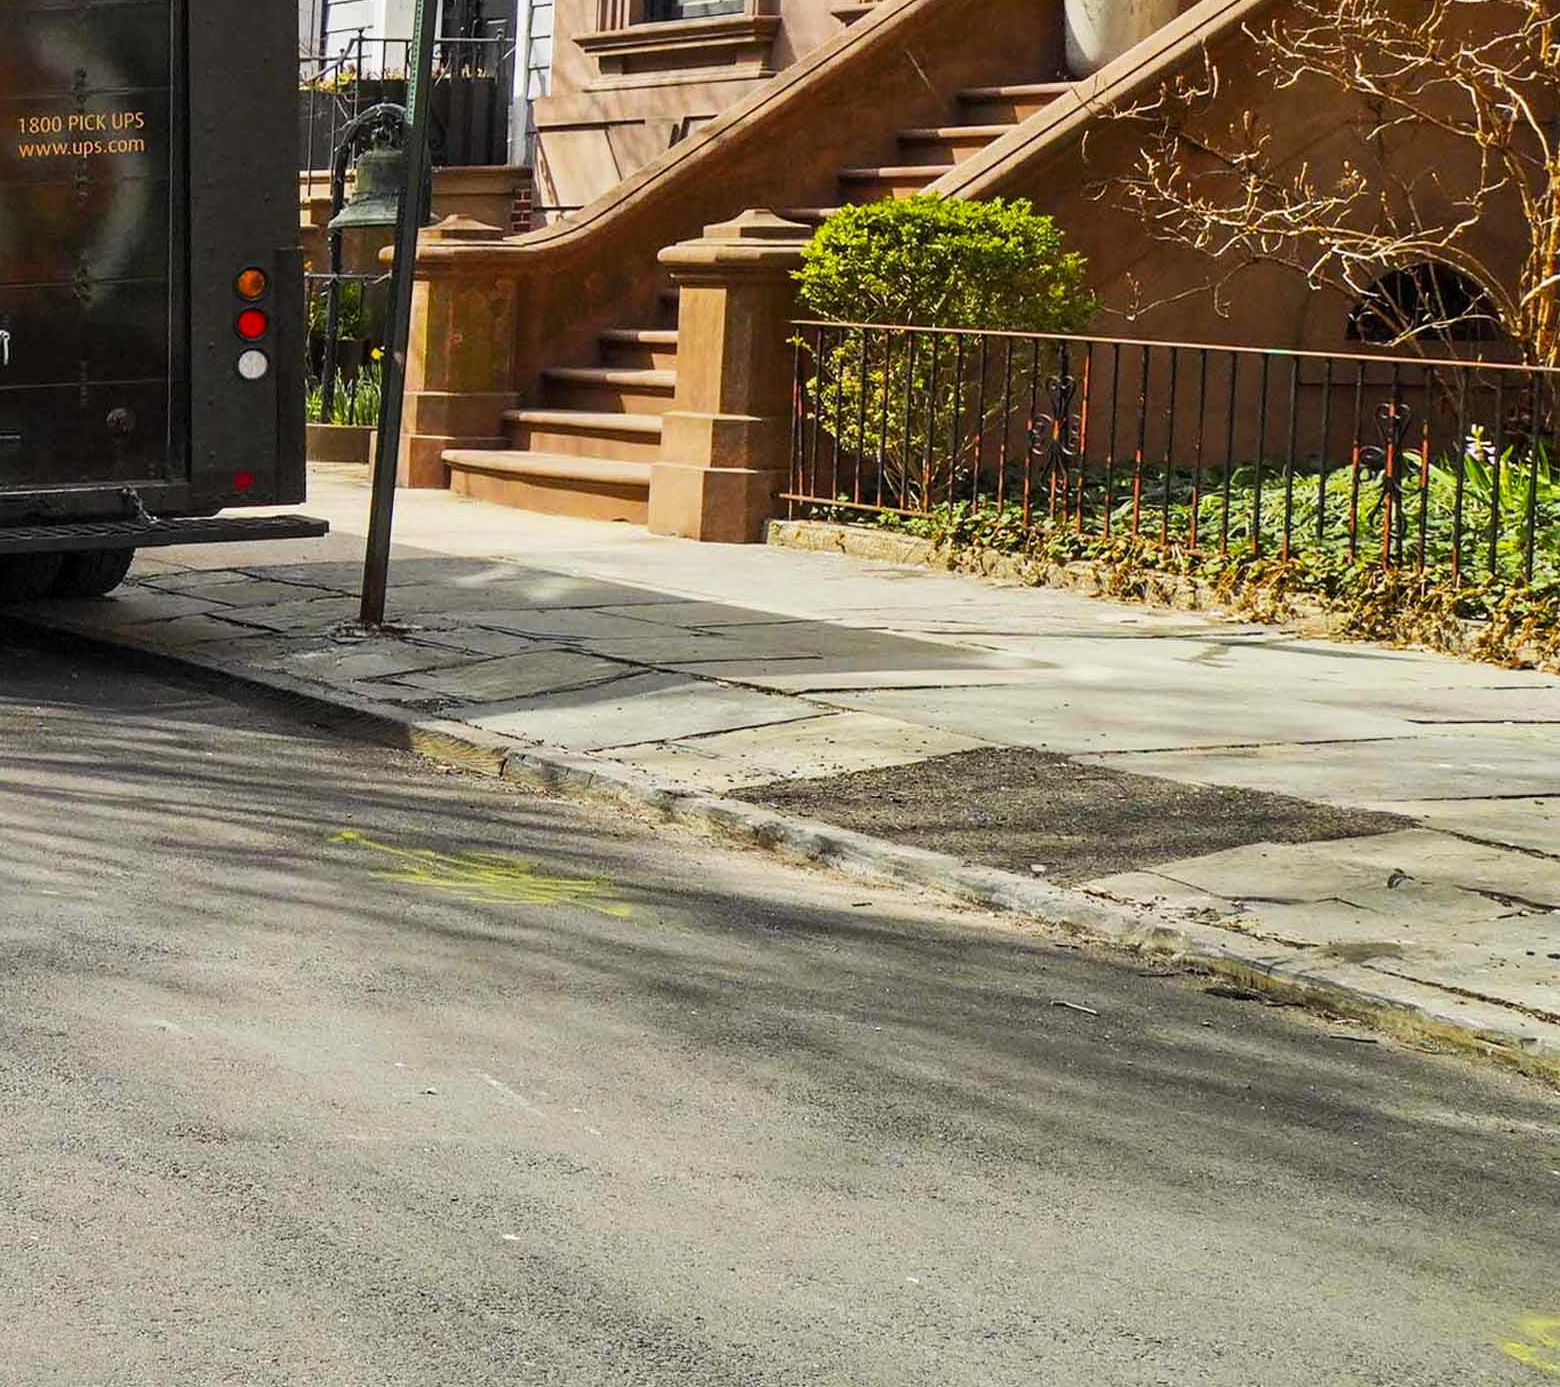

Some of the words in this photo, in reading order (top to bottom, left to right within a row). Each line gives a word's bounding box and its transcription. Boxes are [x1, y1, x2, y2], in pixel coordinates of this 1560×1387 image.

[18, 116, 62, 134] 1800
[68, 114, 106, 132] PICK
[111, 112, 145, 129] UPS
[18, 138, 145, 158] www.ups.com
